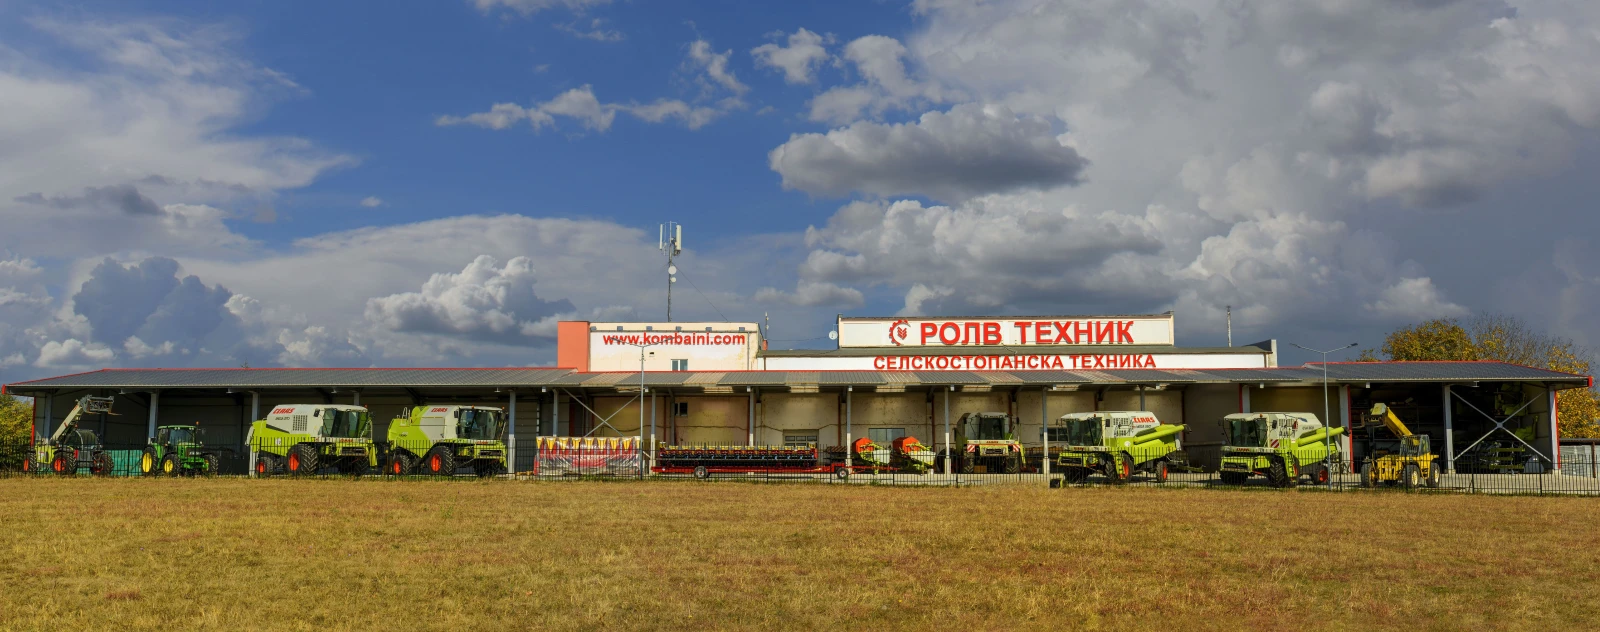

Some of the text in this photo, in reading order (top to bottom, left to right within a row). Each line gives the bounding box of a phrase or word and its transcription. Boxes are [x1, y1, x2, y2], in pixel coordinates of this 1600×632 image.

[603, 332, 746, 346] www.kombaini.com
[920, 320, 1134, 345] РОЛВ ТЕХНИК
[873, 354, 1157, 370] СЕЛСКОСТОПАНСКА ТЕХНИКА
[272, 407, 296, 415] CLAAS
[1132, 416, 1156, 424] CLAAS
